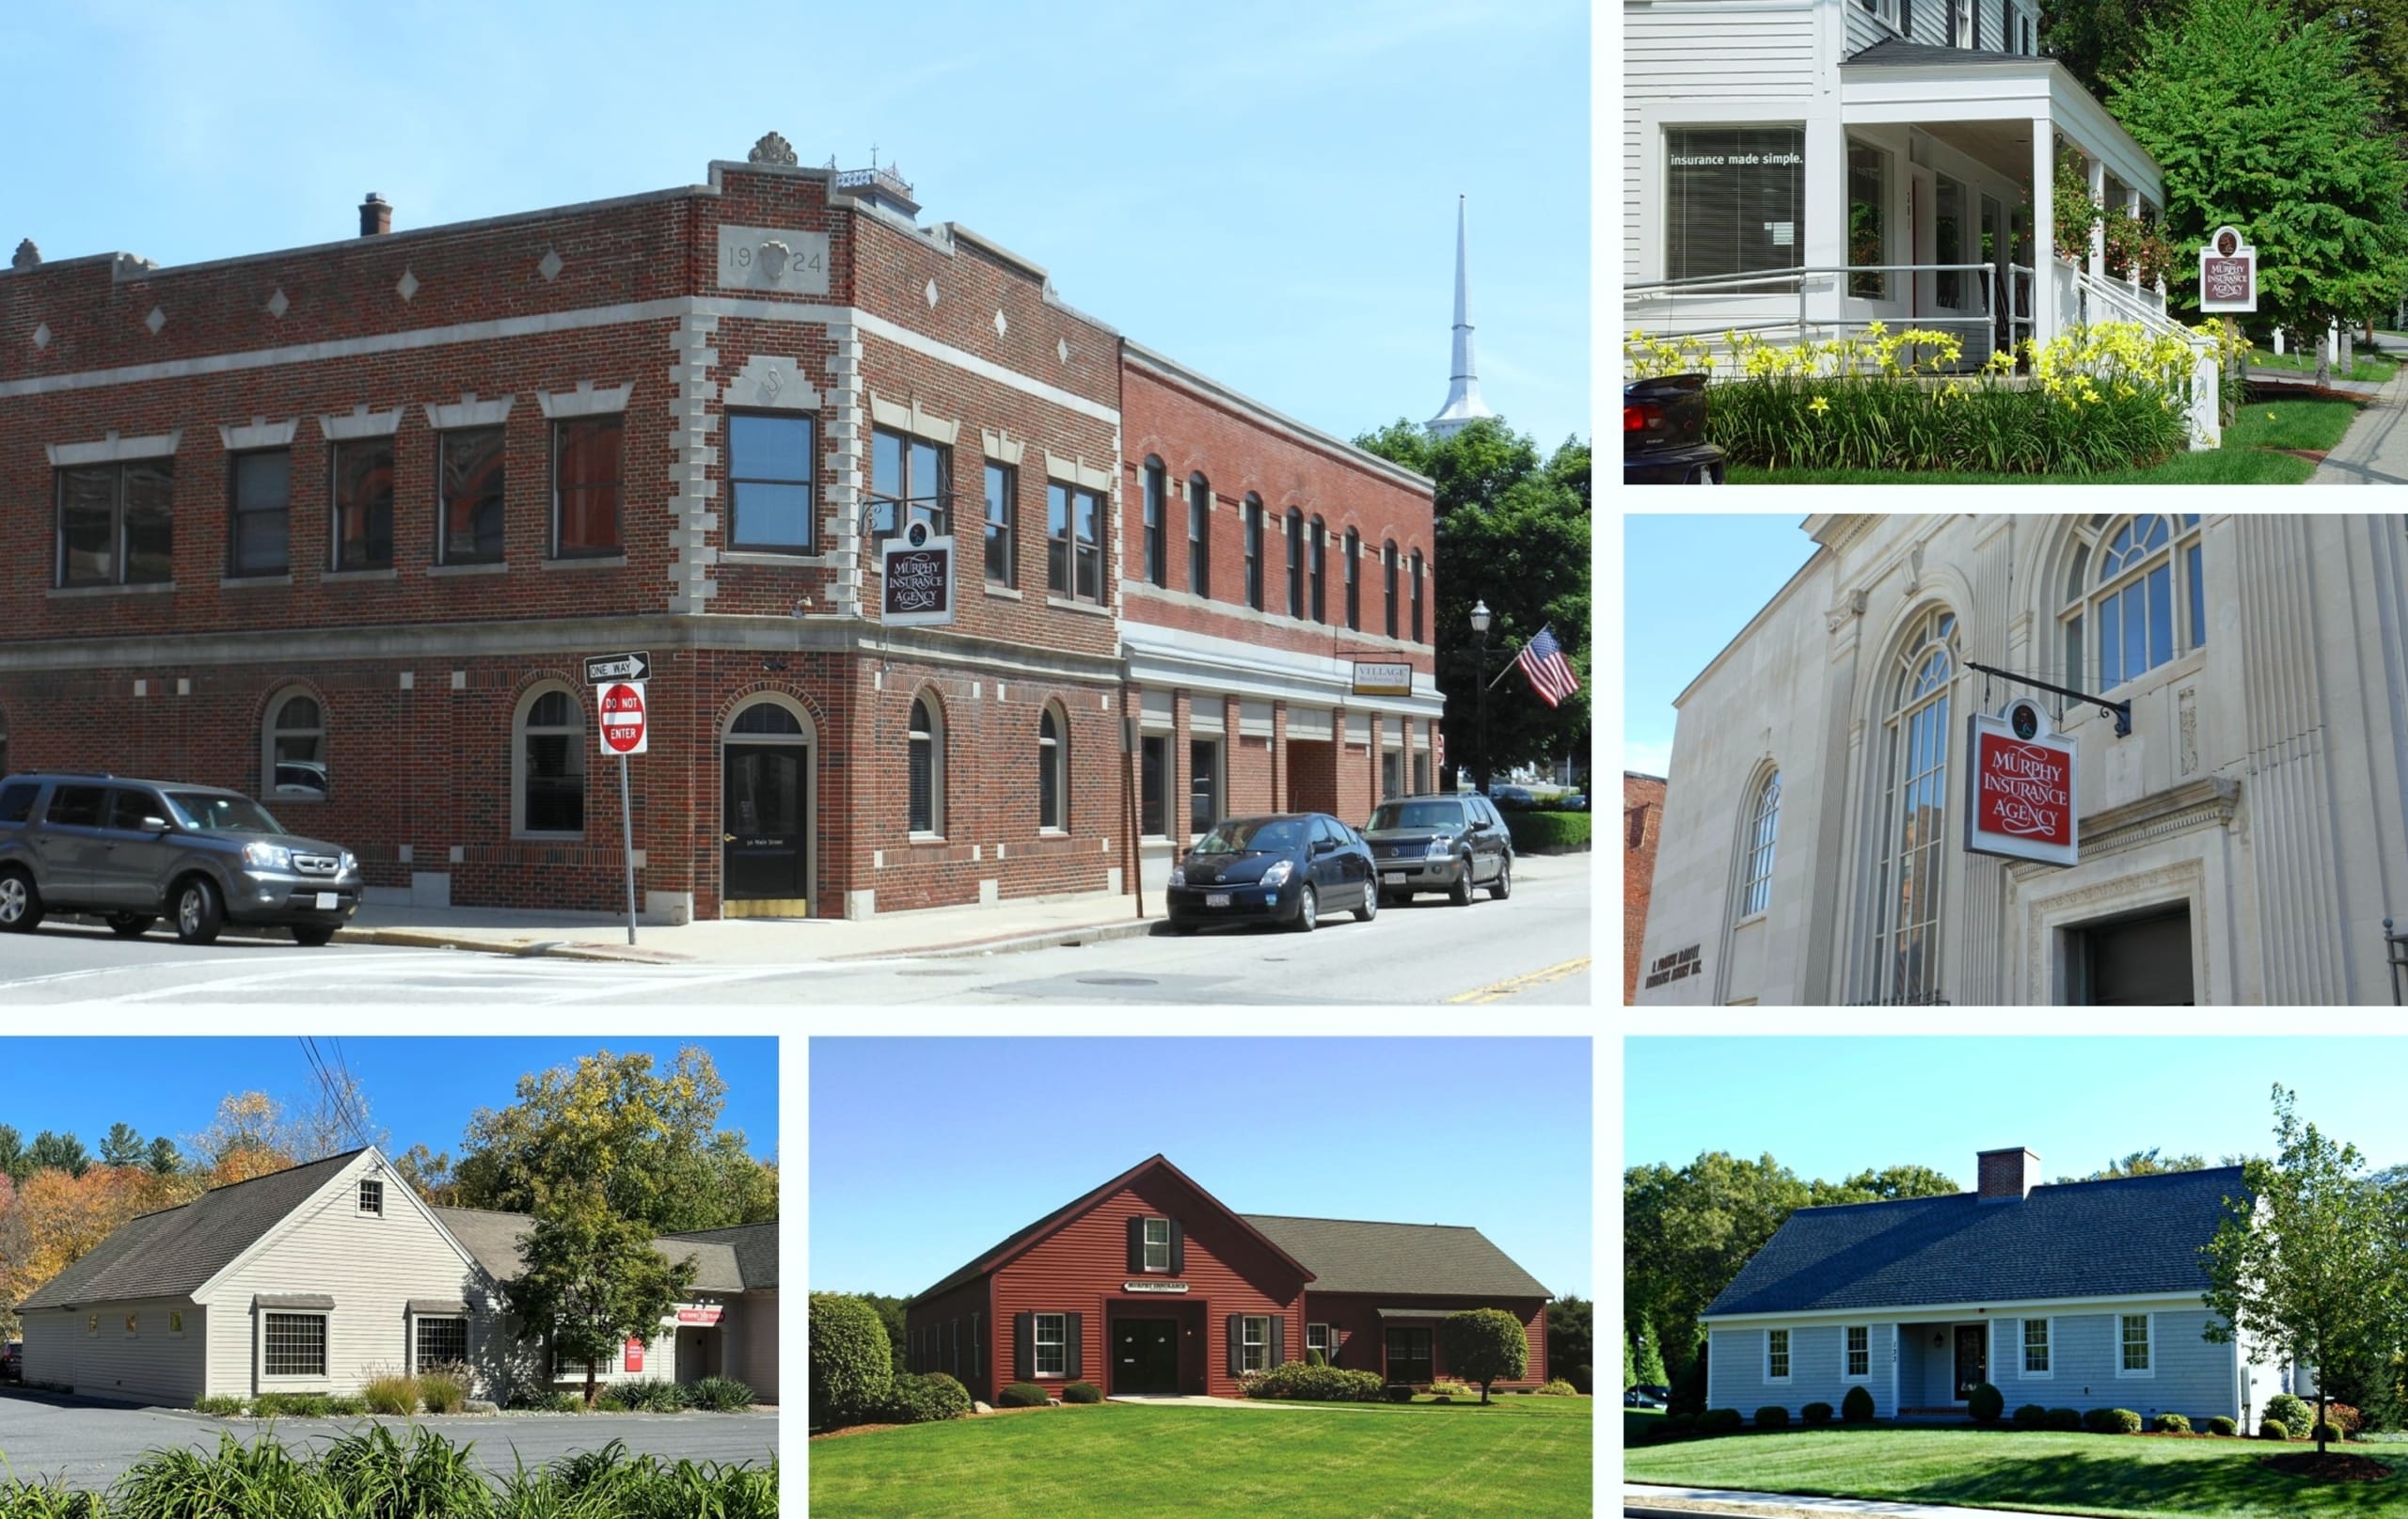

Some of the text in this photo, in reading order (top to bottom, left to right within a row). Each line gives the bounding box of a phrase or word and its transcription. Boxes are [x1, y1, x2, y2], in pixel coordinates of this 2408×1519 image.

[1671, 152, 1803, 166] insurance made simple.
[2210, 262, 2245, 274] MURPHY
[2207, 275, 2247, 283] INSURANCE
[2212, 283, 2243, 294] AGENCY
[894, 559, 941, 576] MURPHY
[889, 577, 943, 590] INSURANCE
[895, 590, 938, 607] AGENCY
[591, 662, 631, 677] ONE WAY
[606, 697, 638, 708] DO NOT
[610, 728, 637, 740] ENTER
[1992, 749, 2062, 783] MURPHY
[1984, 772, 2067, 806] INSURANCE
[1993, 799, 2058, 830] AGENCY
